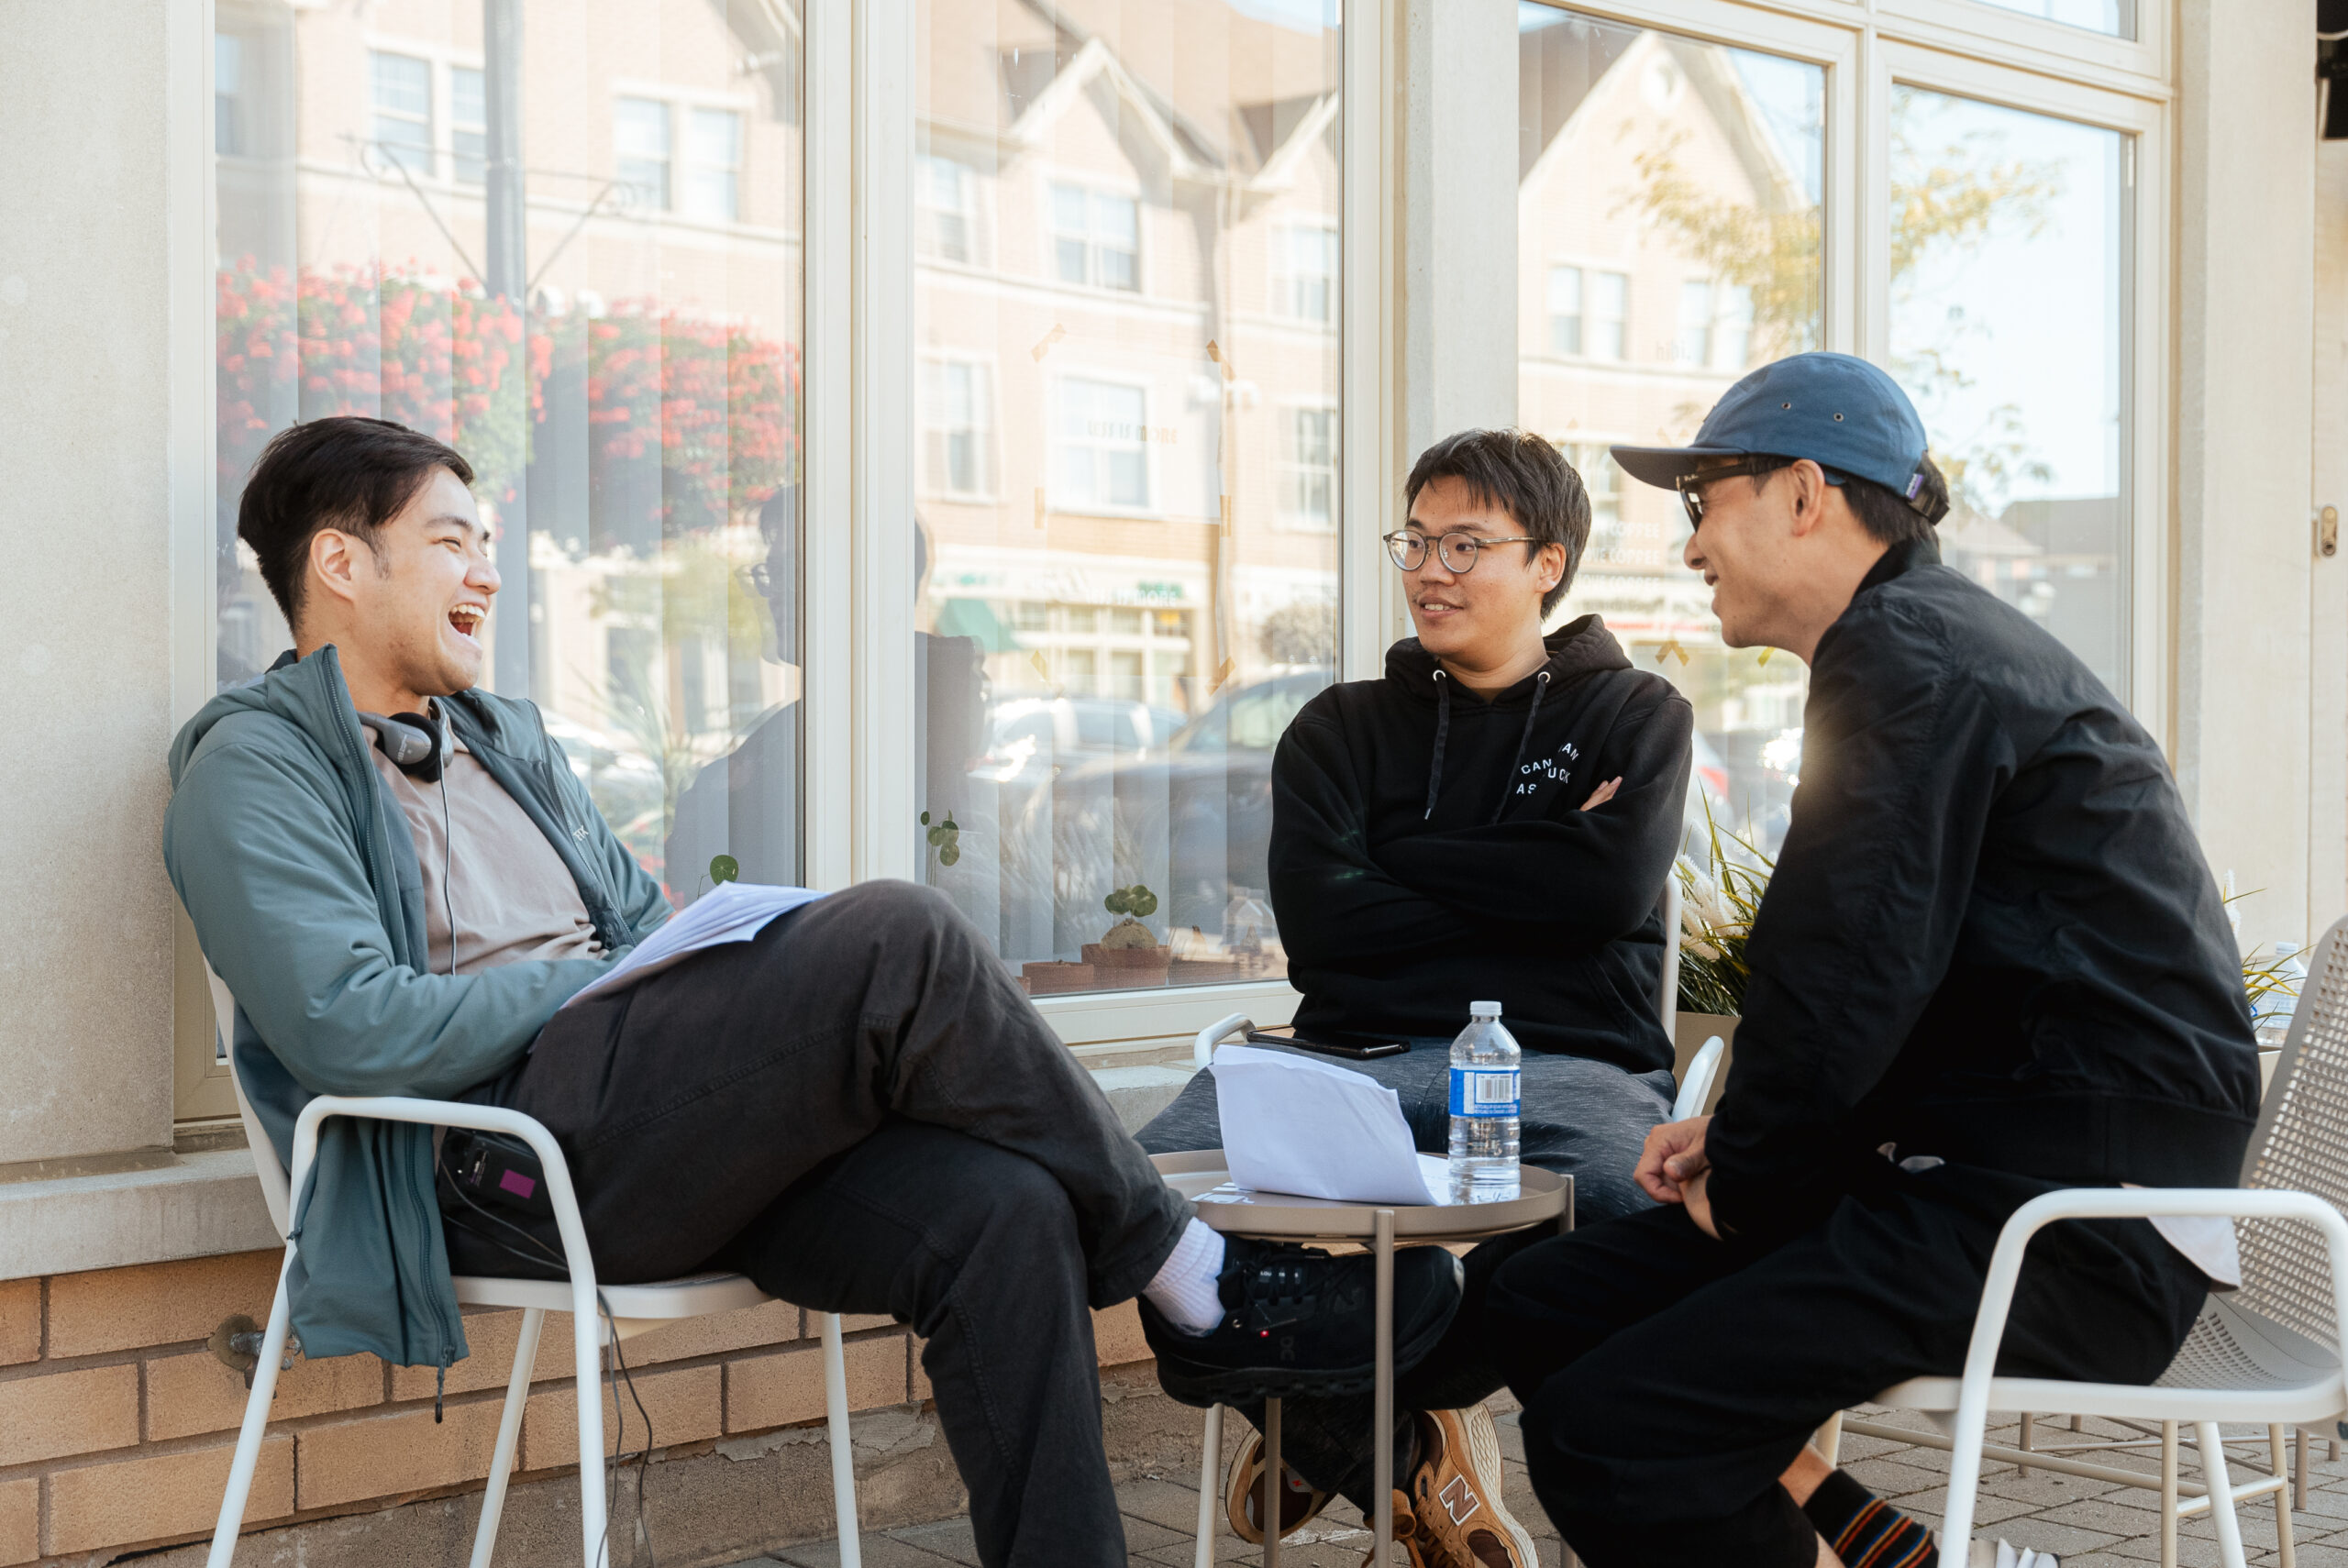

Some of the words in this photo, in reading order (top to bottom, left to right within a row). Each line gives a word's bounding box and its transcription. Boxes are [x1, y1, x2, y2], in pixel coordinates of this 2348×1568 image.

[1136, 425, 1178, 444] MORE
[1610, 521, 1659, 538] COFFEE
[1585, 547, 1607, 564] OVE
[1610, 548, 1659, 565] COFFEE
[1547, 767, 1571, 784] UCK
[1439, 1474, 1480, 1526] N
